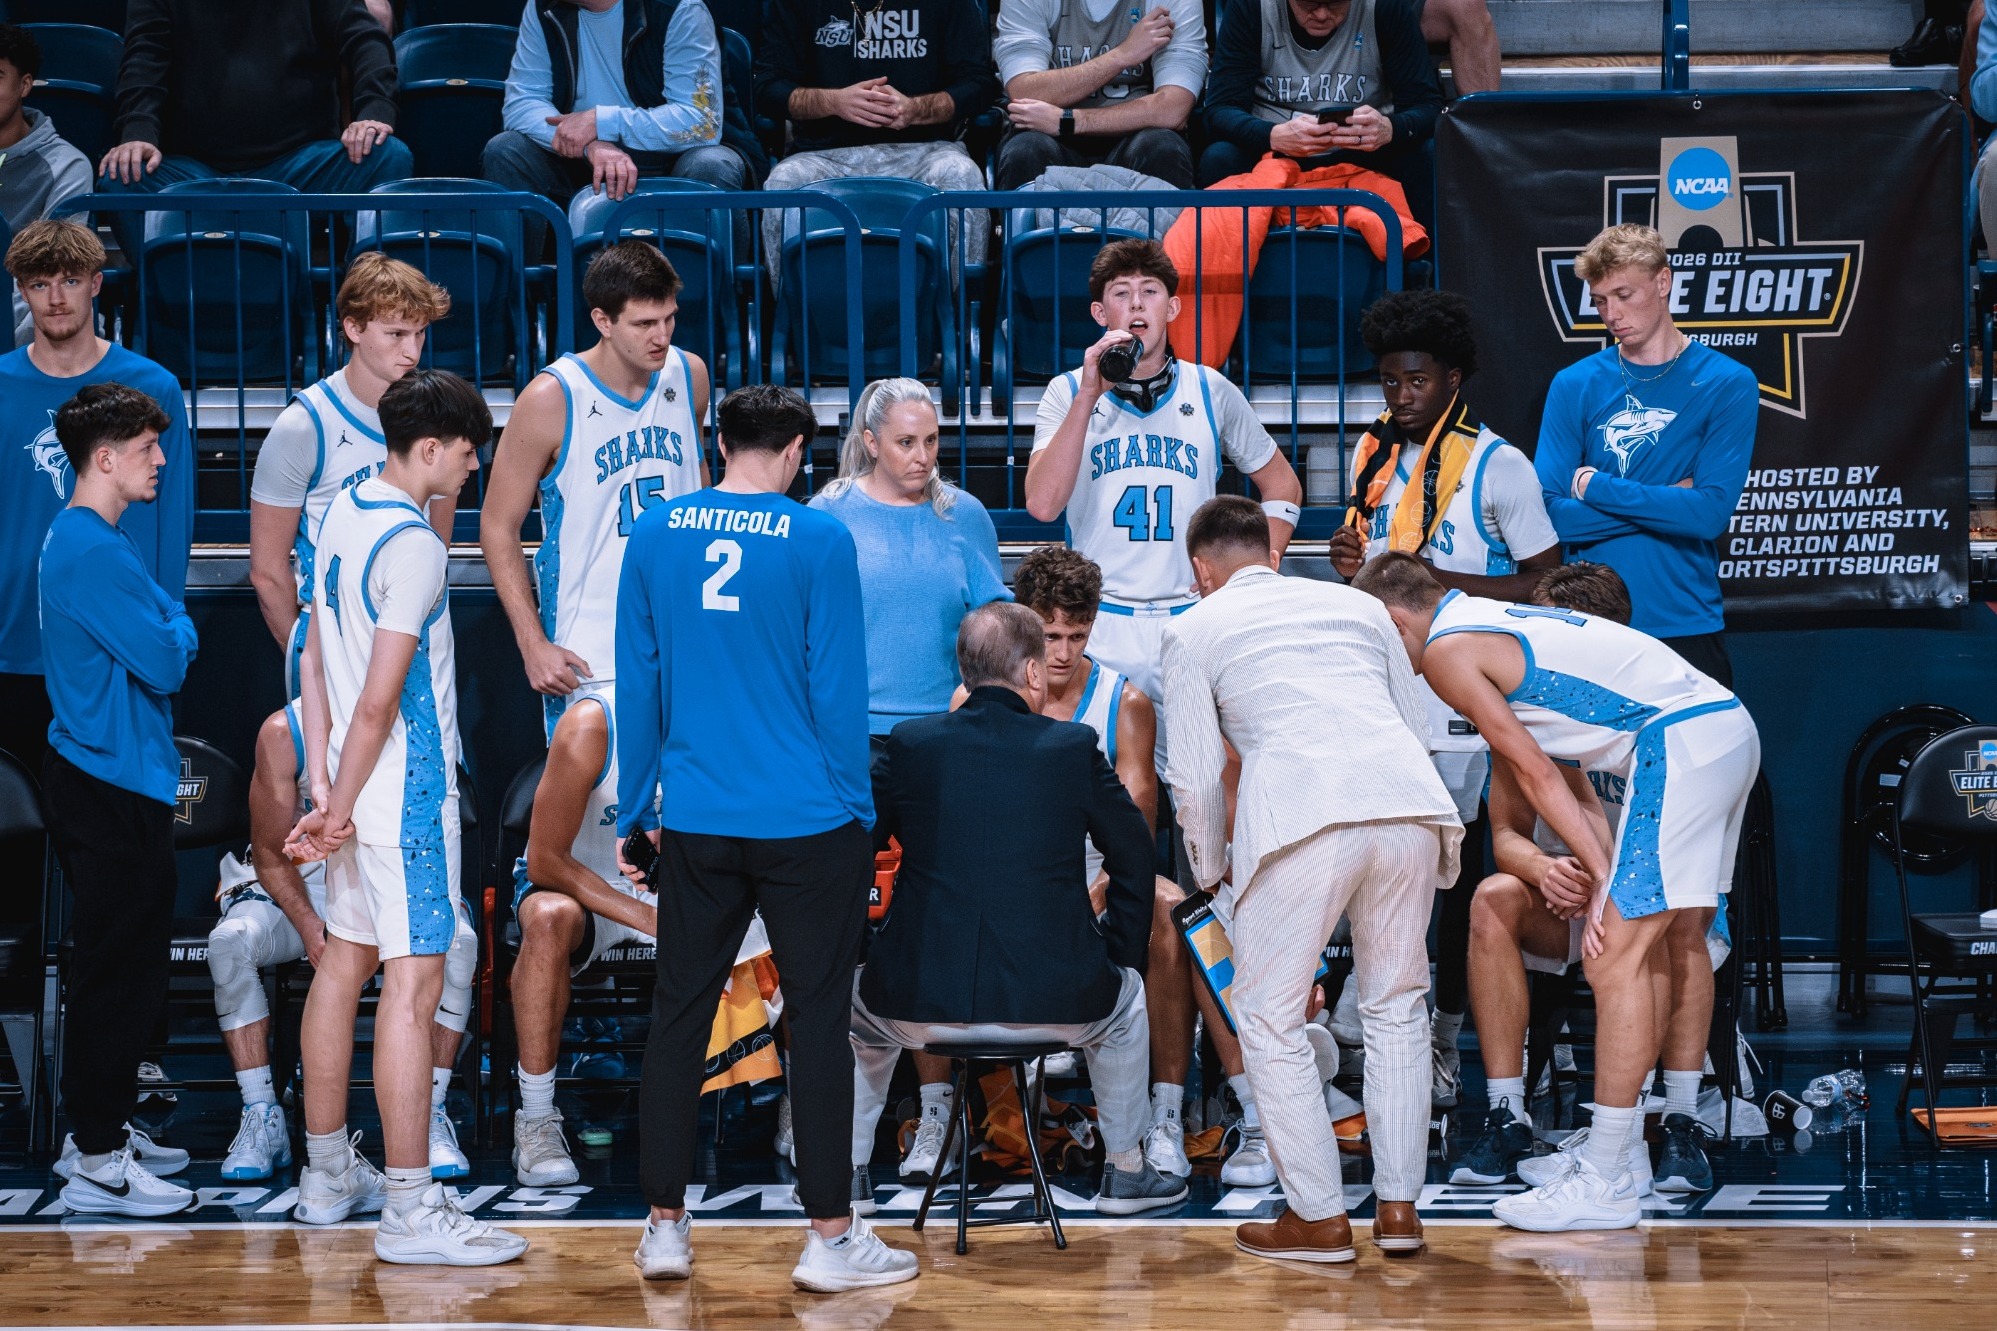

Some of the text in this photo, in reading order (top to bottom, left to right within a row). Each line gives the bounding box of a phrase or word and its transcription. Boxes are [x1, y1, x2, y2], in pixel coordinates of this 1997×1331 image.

[866, 10, 919, 39] NSU
[815, 28, 854, 47] NSU
[857, 39, 927, 59] SHARKS
[1264, 72, 1366, 103] SHARKS
[1674, 177, 1729, 195] NCAA
[1712, 252, 1742, 266] DII
[1703, 268, 1833, 314] EIGHT
[1090, 433, 1199, 481] SHARKS
[1744, 465, 1880, 488] HOSTED BY
[617, 474, 666, 538] 15
[1735, 487, 1903, 511] ENNSYLVANIA
[667, 506, 791, 539] SANTICOLA
[1113, 484, 1174, 542] 41
[1728, 508, 1950, 534] TERN UNIVERSITY,
[1729, 532, 1895, 556] CLARION AND
[702, 538, 743, 612] 2
[1717, 554, 1940, 579] ORTSPITTSBURGH
[176, 783, 200, 796] GHT
[1960, 776, 1991, 789] ELITE
[170, 947, 209, 961] IN HER
[600, 947, 657, 962] WIN HERE
[1325, 946, 1340, 958] IN
